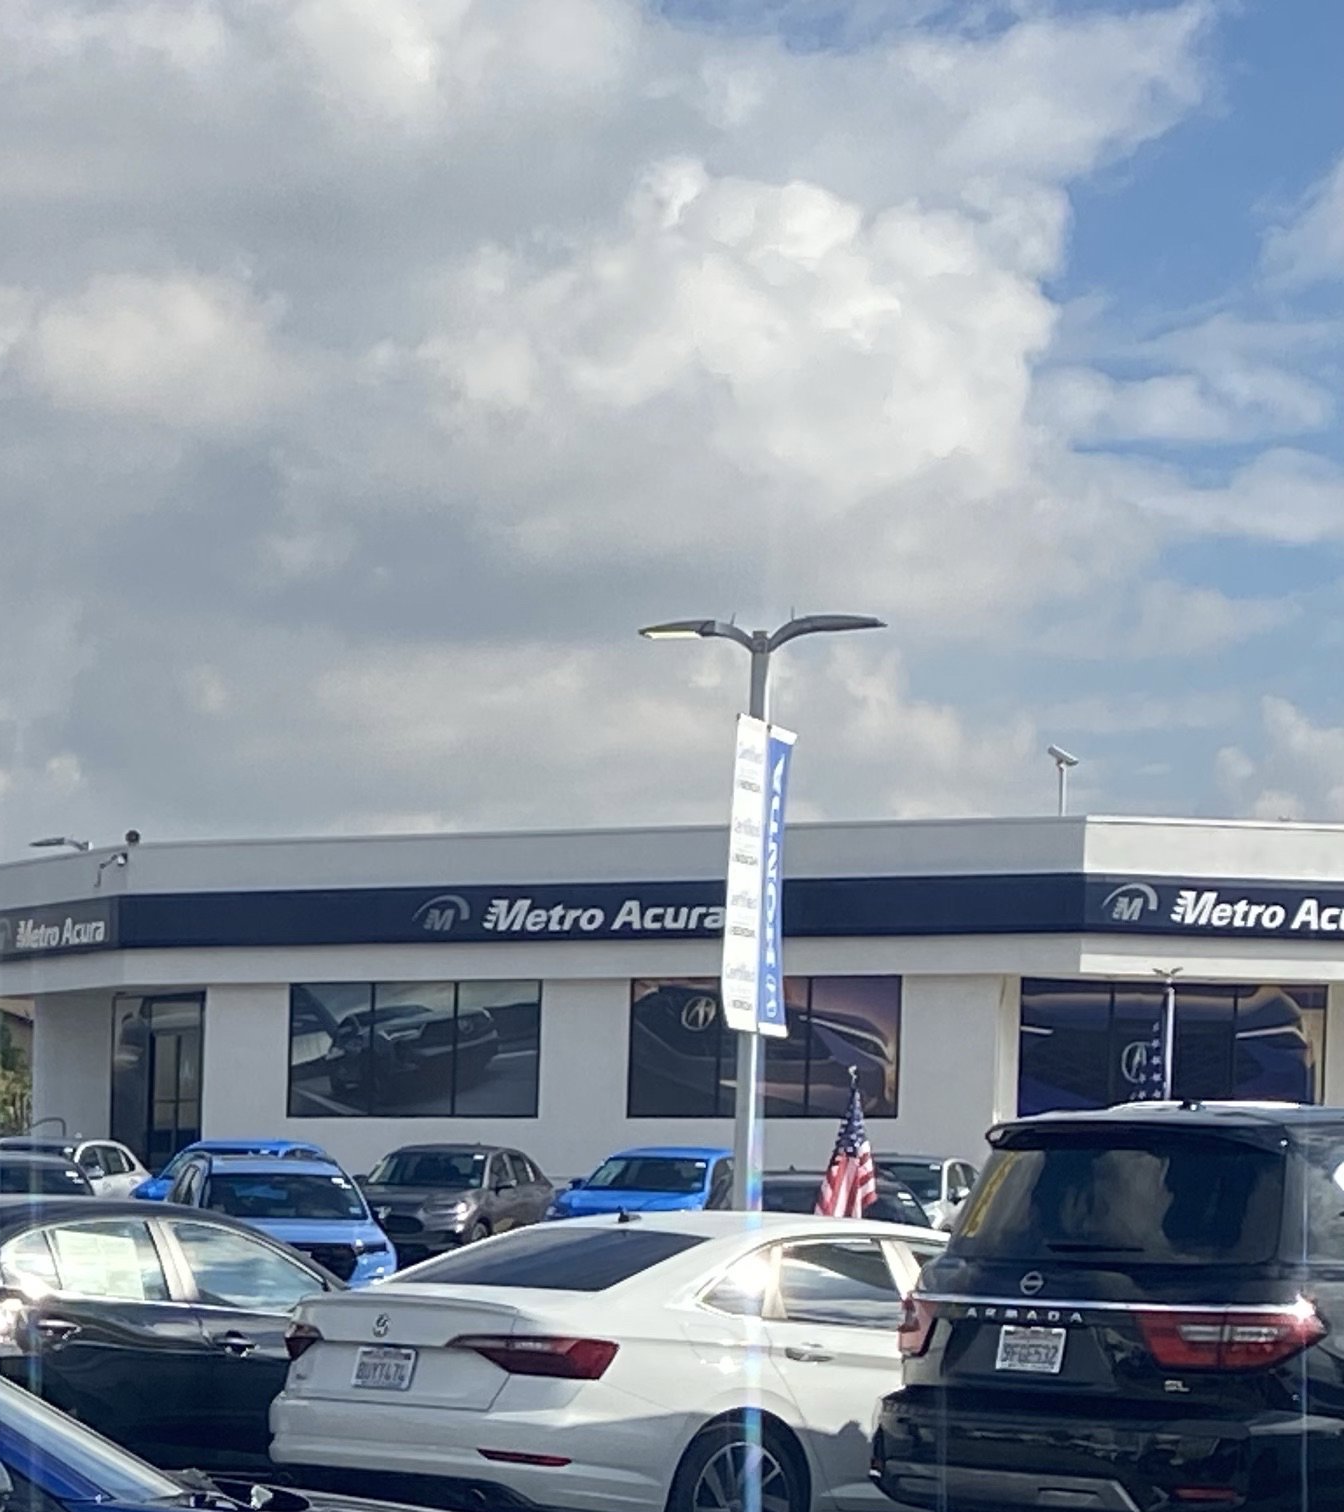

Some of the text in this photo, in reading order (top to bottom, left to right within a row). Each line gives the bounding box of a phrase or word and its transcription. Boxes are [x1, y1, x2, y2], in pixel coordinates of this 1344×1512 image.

[480, 898, 605, 931] Metro
[611, 899, 726, 930] Acura
[1170, 889, 1286, 929] Metro
[1290, 898, 1344, 931] Ac
[15, 917, 105, 949] Metro Acura
[966, 1306, 1083, 1323] ARMADA
